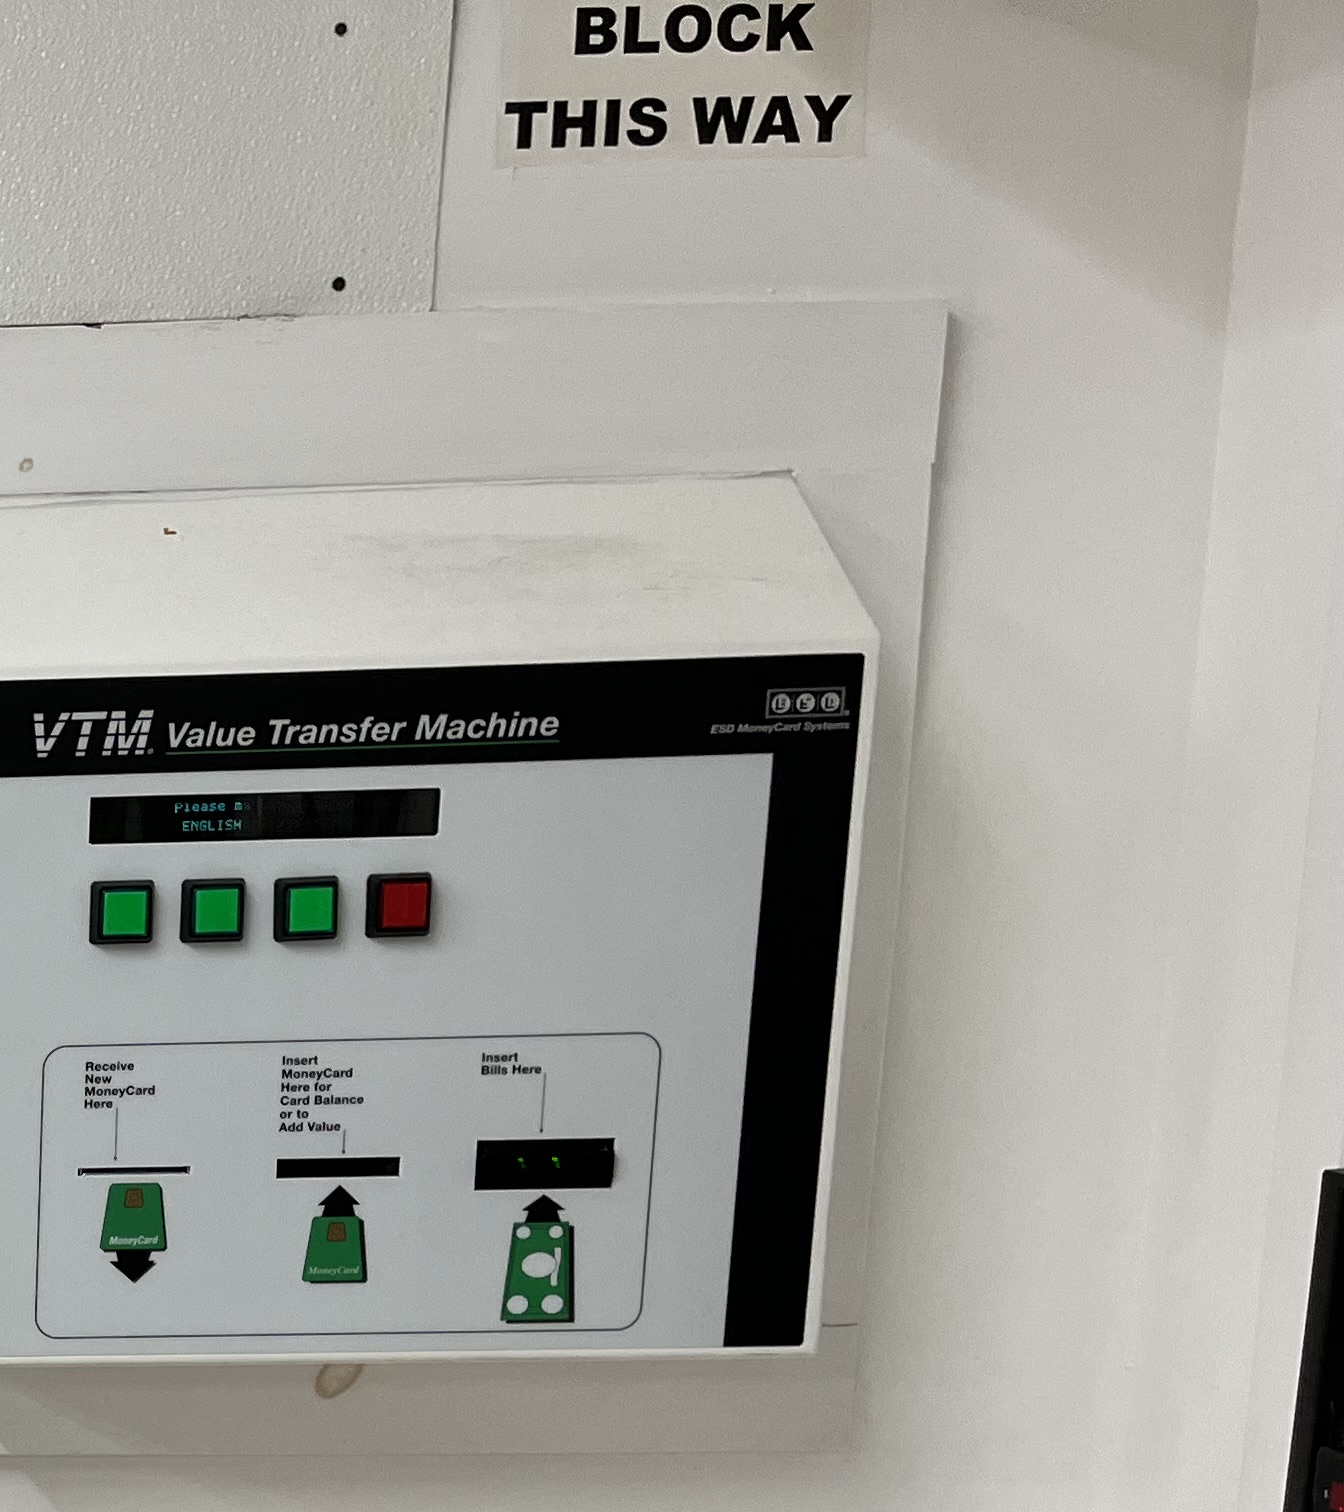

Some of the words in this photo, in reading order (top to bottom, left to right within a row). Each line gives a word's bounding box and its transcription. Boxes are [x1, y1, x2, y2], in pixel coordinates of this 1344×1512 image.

[574, 2, 816, 56] BLOCK
[504, 97, 668, 149] THIS
[692, 94, 853, 145] WAY
[33, 709, 155, 758] VTM
[168, 721, 256, 748] Value
[269, 715, 407, 745] Transfer
[414, 711, 560, 741] Machine
[174, 802, 226, 813] Please
[182, 819, 242, 831] ENGLISH
[282, 1055, 318, 1065] Insert
[481, 1052, 519, 1062] Insert
[85, 1061, 134, 1071] Receive
[481, 1065, 508, 1075] Bills
[512, 1064, 542, 1075] Here
[85, 1074, 112, 1084] New
[281, 1067, 353, 1080] MoneyCard
[84, 1085, 156, 1098] MoneyCard
[281, 1082, 310, 1092] Here
[314, 1081, 332, 1092] for
[84, 1099, 113, 1109] Here
[280, 1095, 310, 1106] Card
[314, 1094, 364, 1105] Balance
[279, 1111, 293, 1119] or
[296, 1109, 309, 1119] to
[279, 1121, 304, 1132] Add
[307, 1121, 341, 1132] Value
[108, 1235, 159, 1246] MoneyCard
[307, 1265, 360, 1275] MoneyCard
